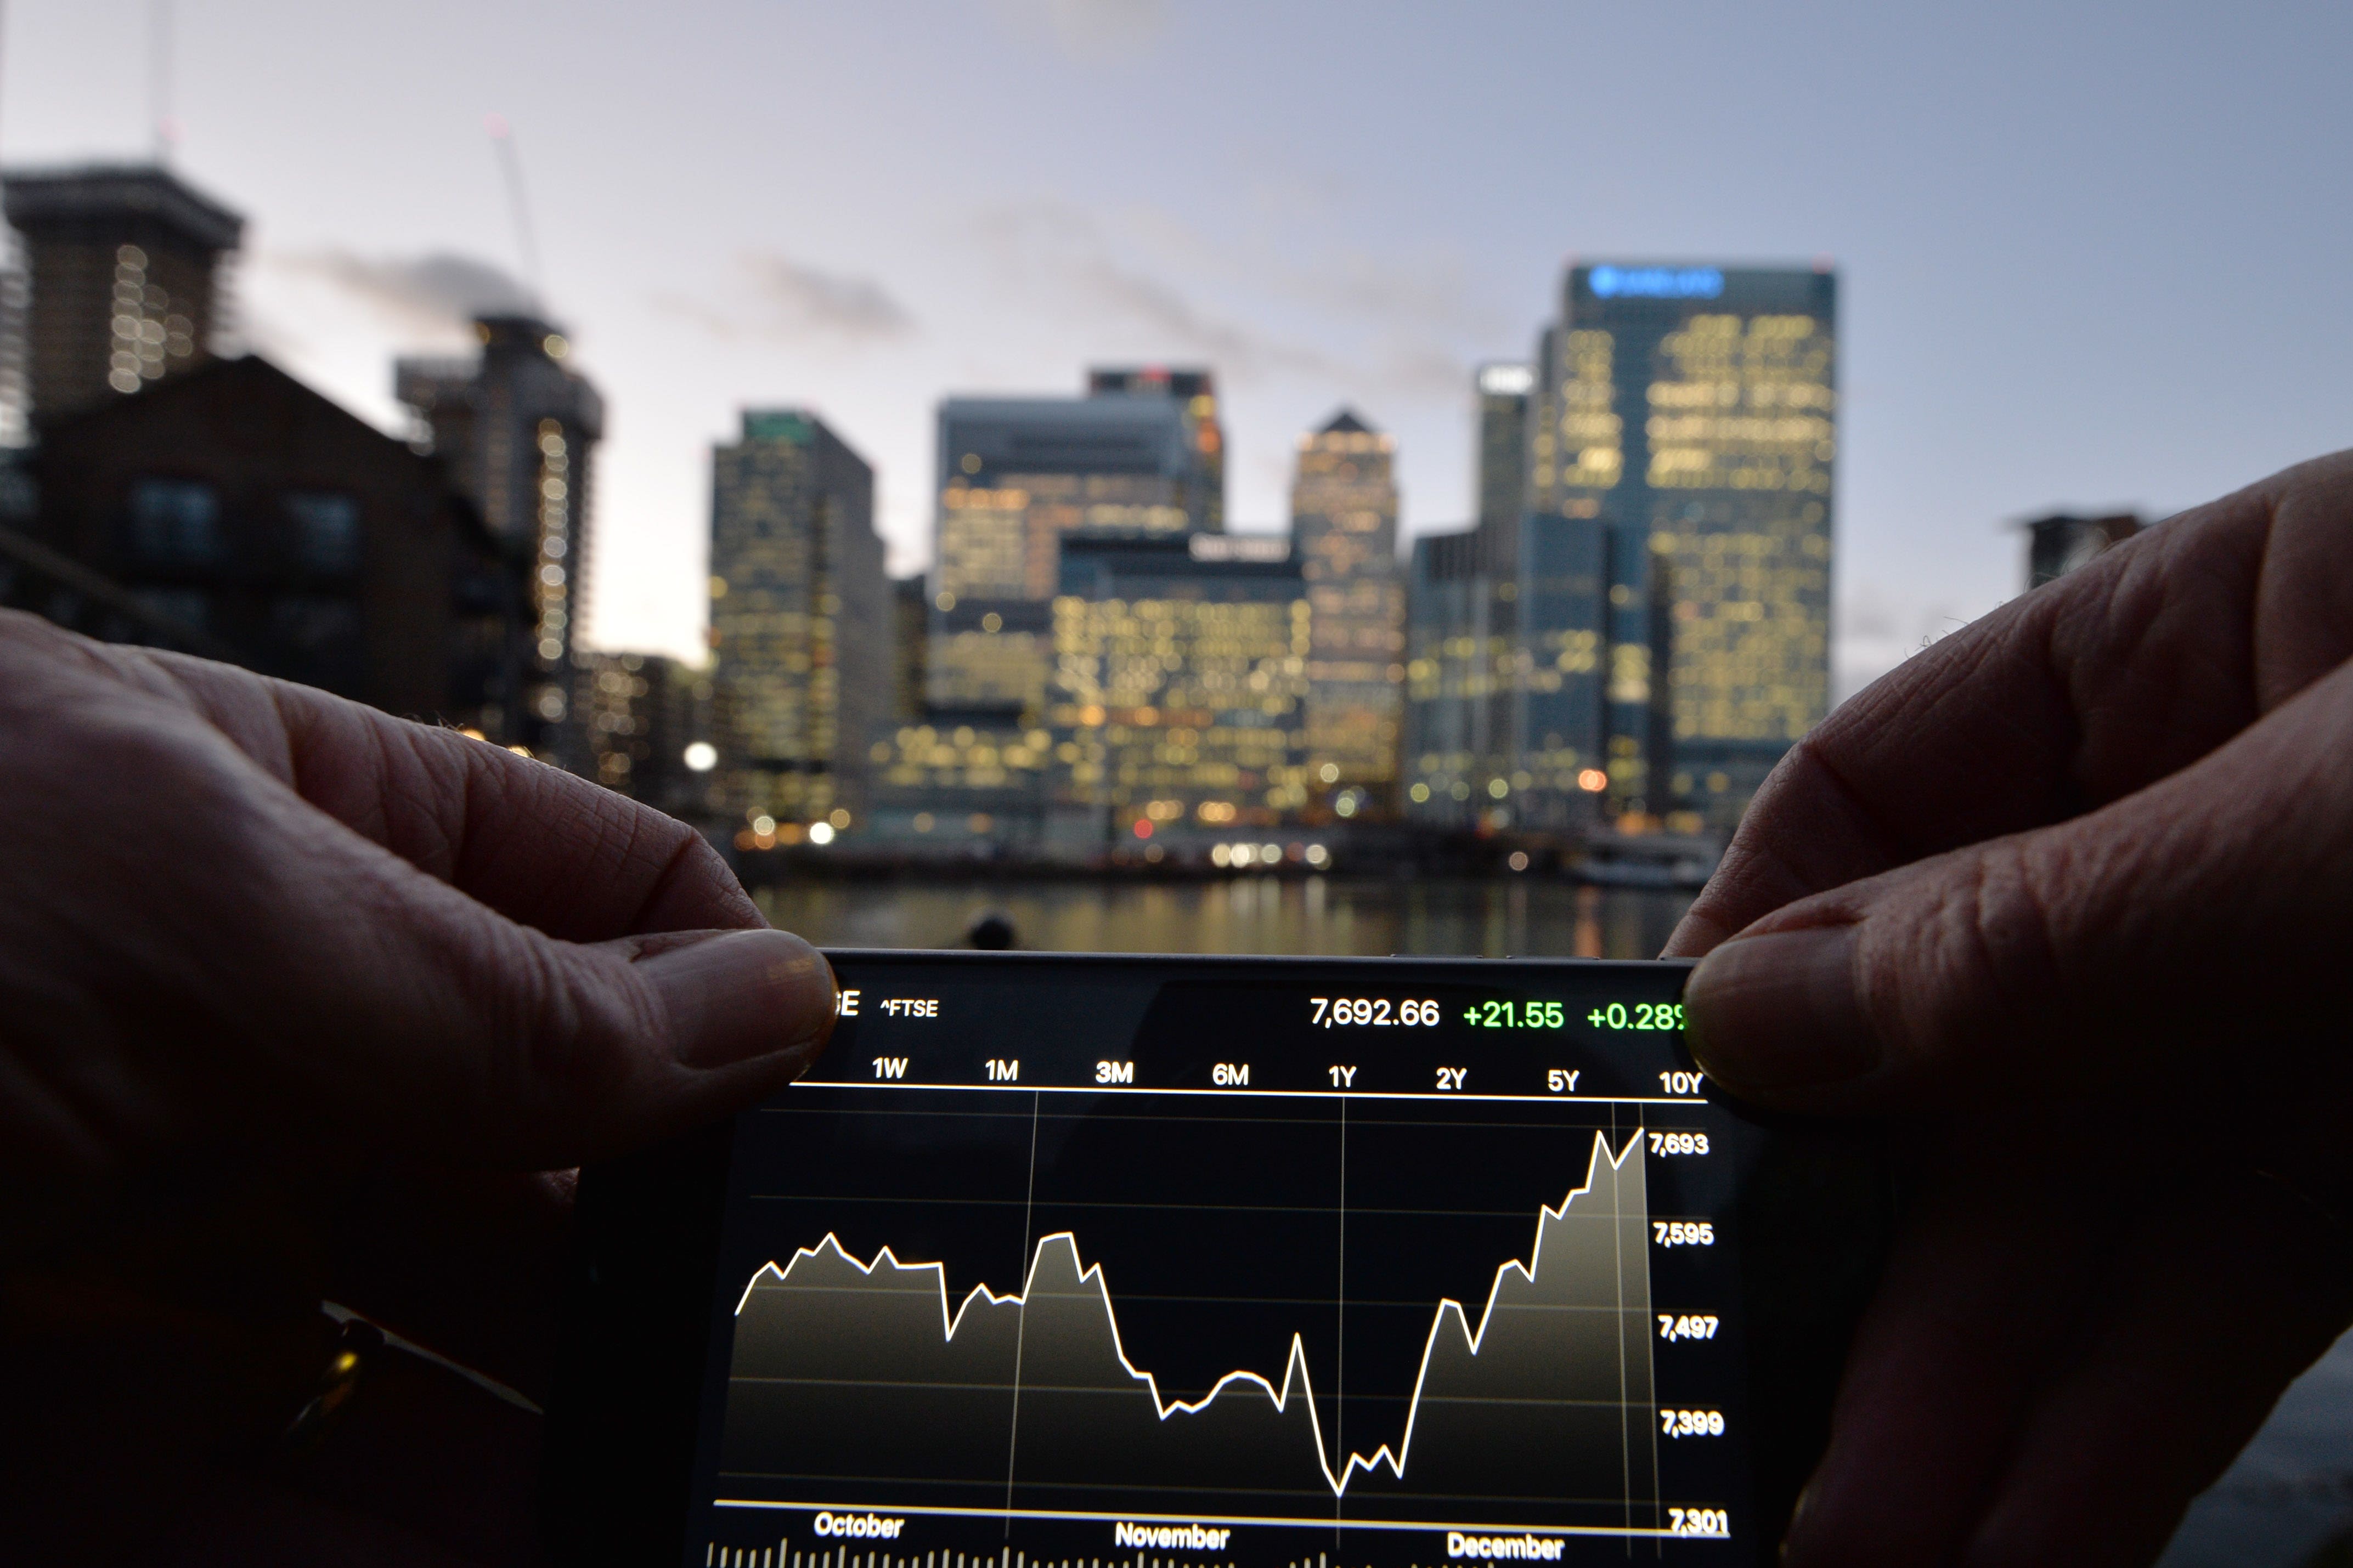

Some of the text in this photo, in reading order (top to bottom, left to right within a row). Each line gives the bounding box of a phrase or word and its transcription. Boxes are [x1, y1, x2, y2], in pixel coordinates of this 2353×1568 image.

[880, 999, 939, 1018] ^FTSE
[1310, 997, 1440, 1029] 7,692.66
[1463, 1001, 1565, 1029] +21.55
[872, 1056, 1704, 1095] 1W 1M 3M 6M 1Y 2Y 5Y 10Y
[1648, 1132, 1711, 1158] 7,693
[1652, 1221, 1715, 1249] 7,595
[1657, 1314, 1719, 1343] 7,497
[1660, 1409, 1725, 1439] 7,399
[814, 1511, 905, 1539] October
[1115, 1521, 1231, 1551] November
[1668, 1508, 1729, 1538] 7,301
[1447, 1531, 1566, 1561] December
